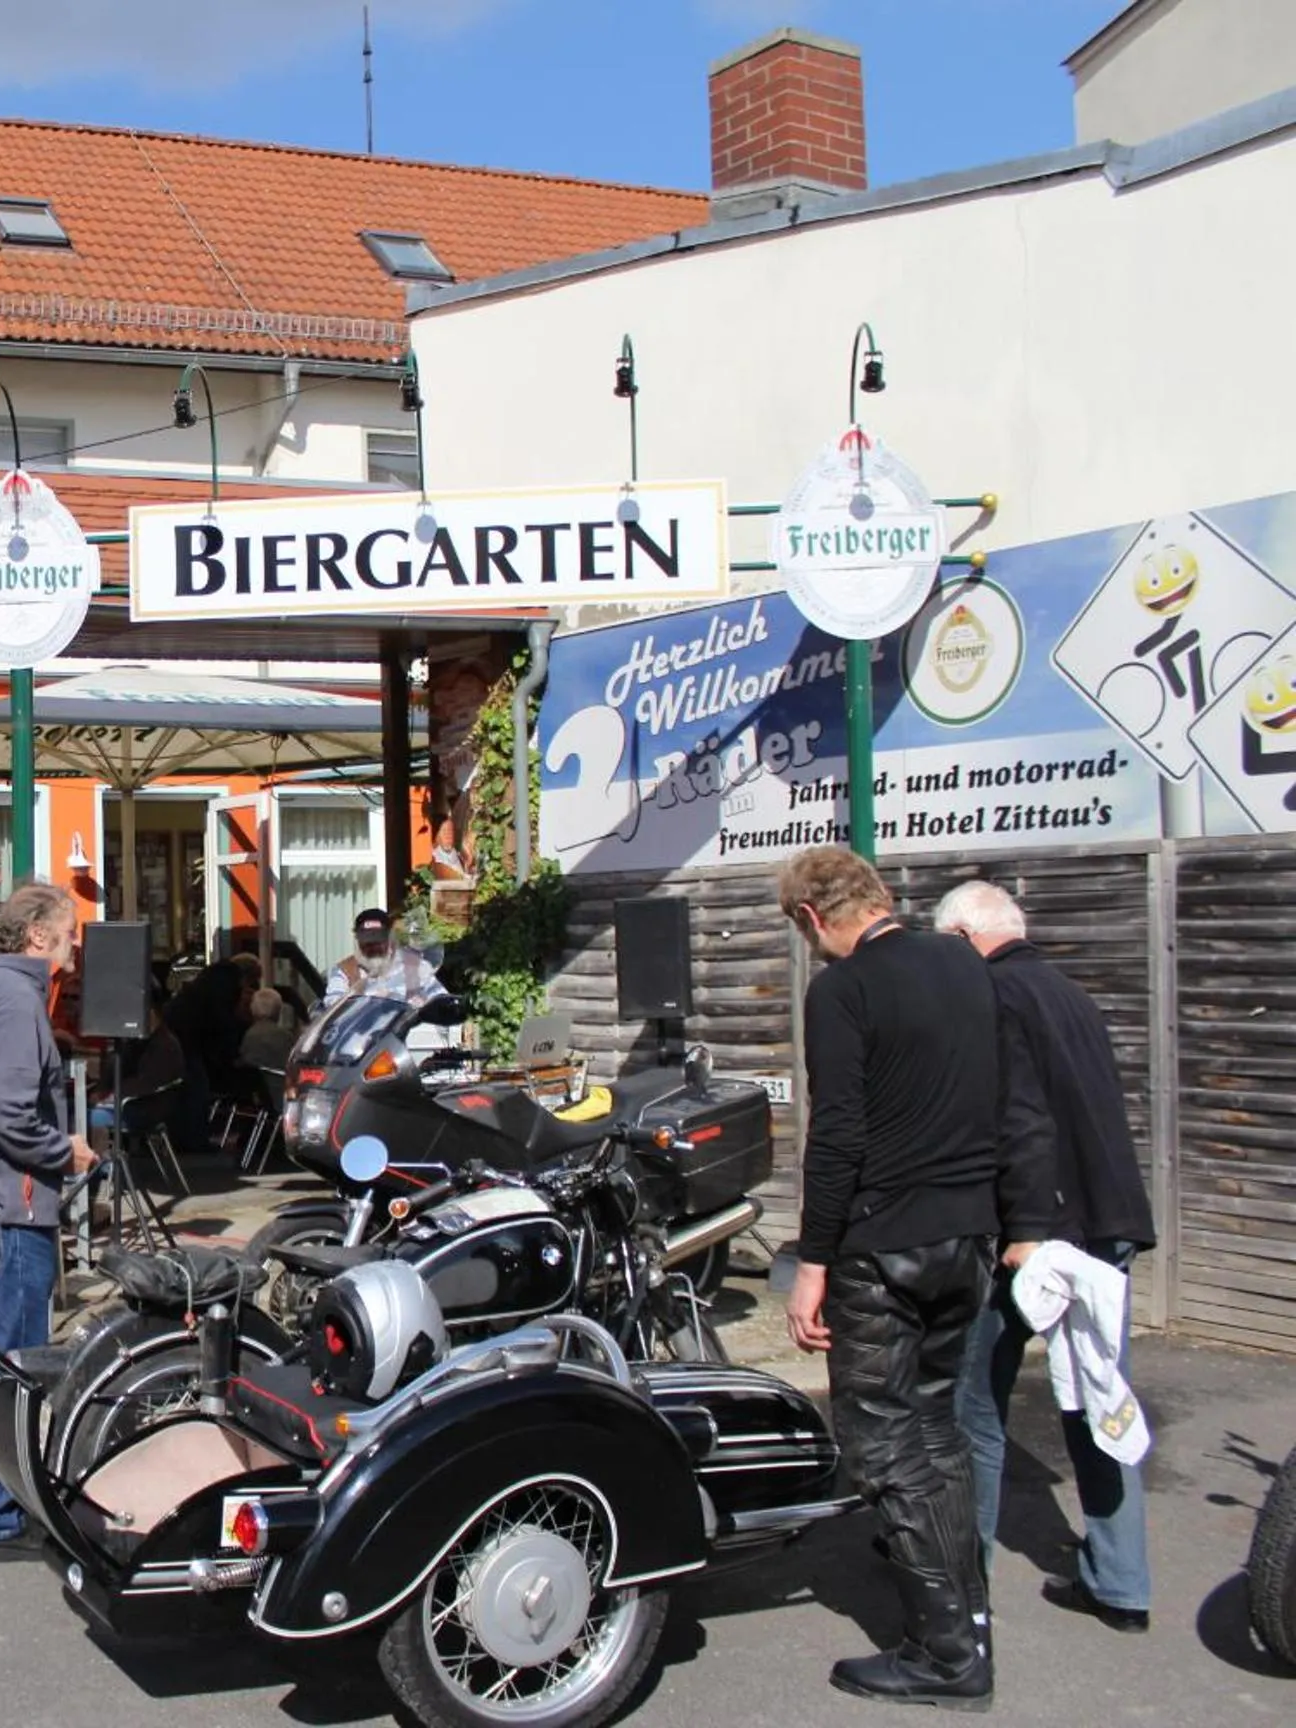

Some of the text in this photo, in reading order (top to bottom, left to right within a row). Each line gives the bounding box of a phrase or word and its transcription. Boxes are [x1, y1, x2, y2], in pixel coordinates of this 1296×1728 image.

[173, 518, 680, 597] BIERGARTEN
[786, 523, 931, 560] Freiberger
[606, 600, 768, 707] Herzlich
[789, 749, 1129, 810] fahrrd- und motorrad-
[719, 797, 1113, 856] freundlichsn Hotel Zittau's
